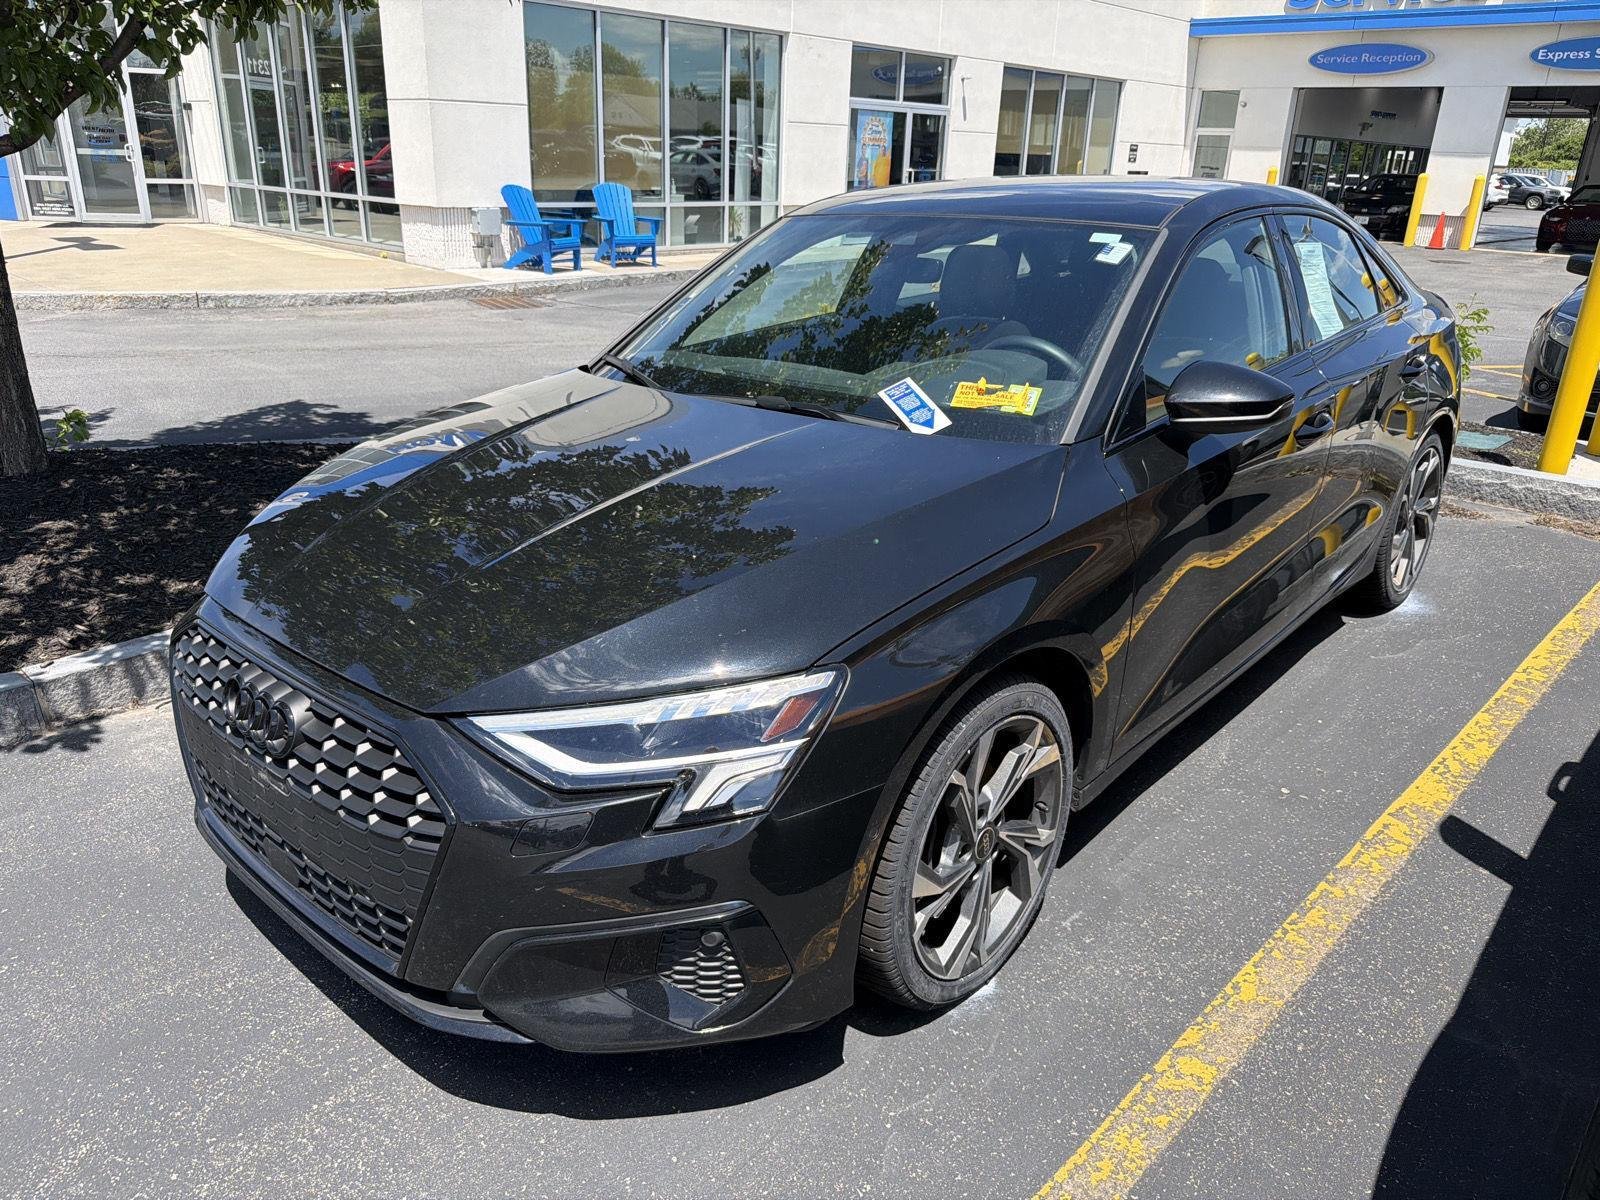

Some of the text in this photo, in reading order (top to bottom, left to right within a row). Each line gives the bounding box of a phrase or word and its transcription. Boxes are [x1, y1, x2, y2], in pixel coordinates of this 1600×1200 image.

[1316, 52, 1421, 65] Service Reception
[1537, 49, 1591, 63] Express
